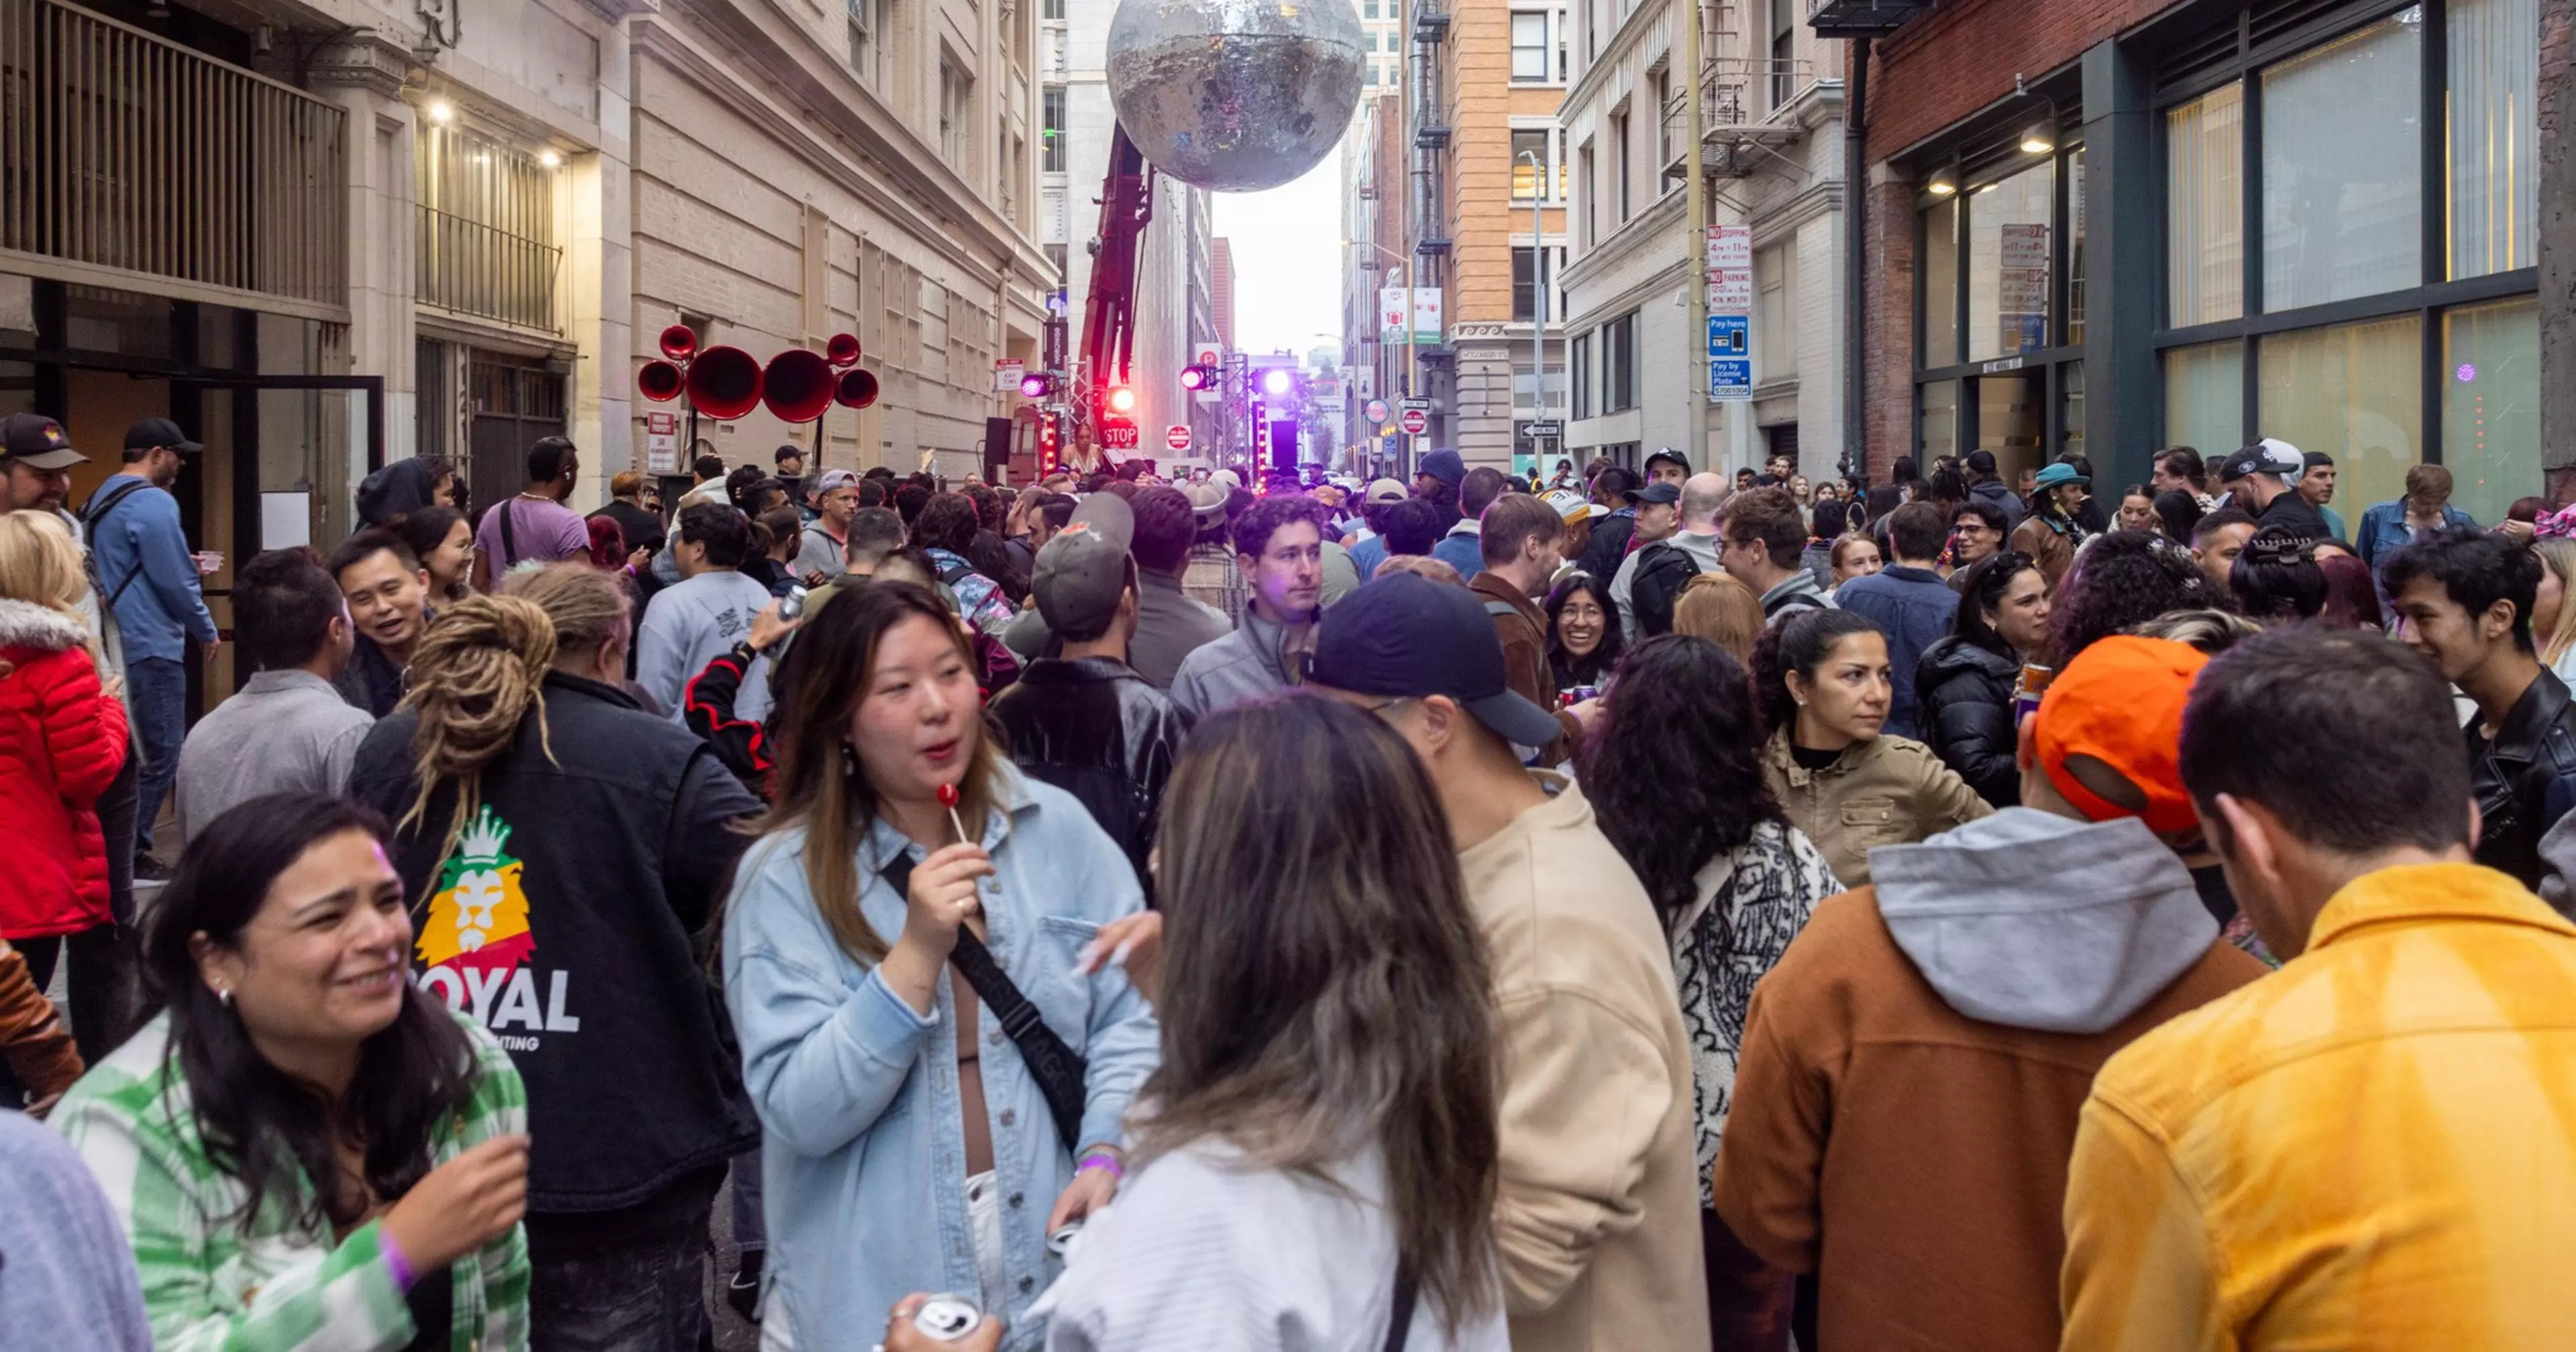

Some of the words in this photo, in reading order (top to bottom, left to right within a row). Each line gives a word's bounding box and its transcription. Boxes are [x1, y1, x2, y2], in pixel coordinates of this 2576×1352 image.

[1709, 228, 1719, 237] NO
[1721, 229, 1748, 237] STOPPING
[1711, 272, 1721, 282] NO
[1724, 274, 1750, 282] PARKING
[1711, 320, 1726, 329] Pay
[1727, 319, 1746, 328] here
[1713, 362, 1727, 372] Pay
[1729, 362, 1739, 372] by
[1106, 429, 1136, 443] STOP
[406, 965, 580, 1033] OYAL
